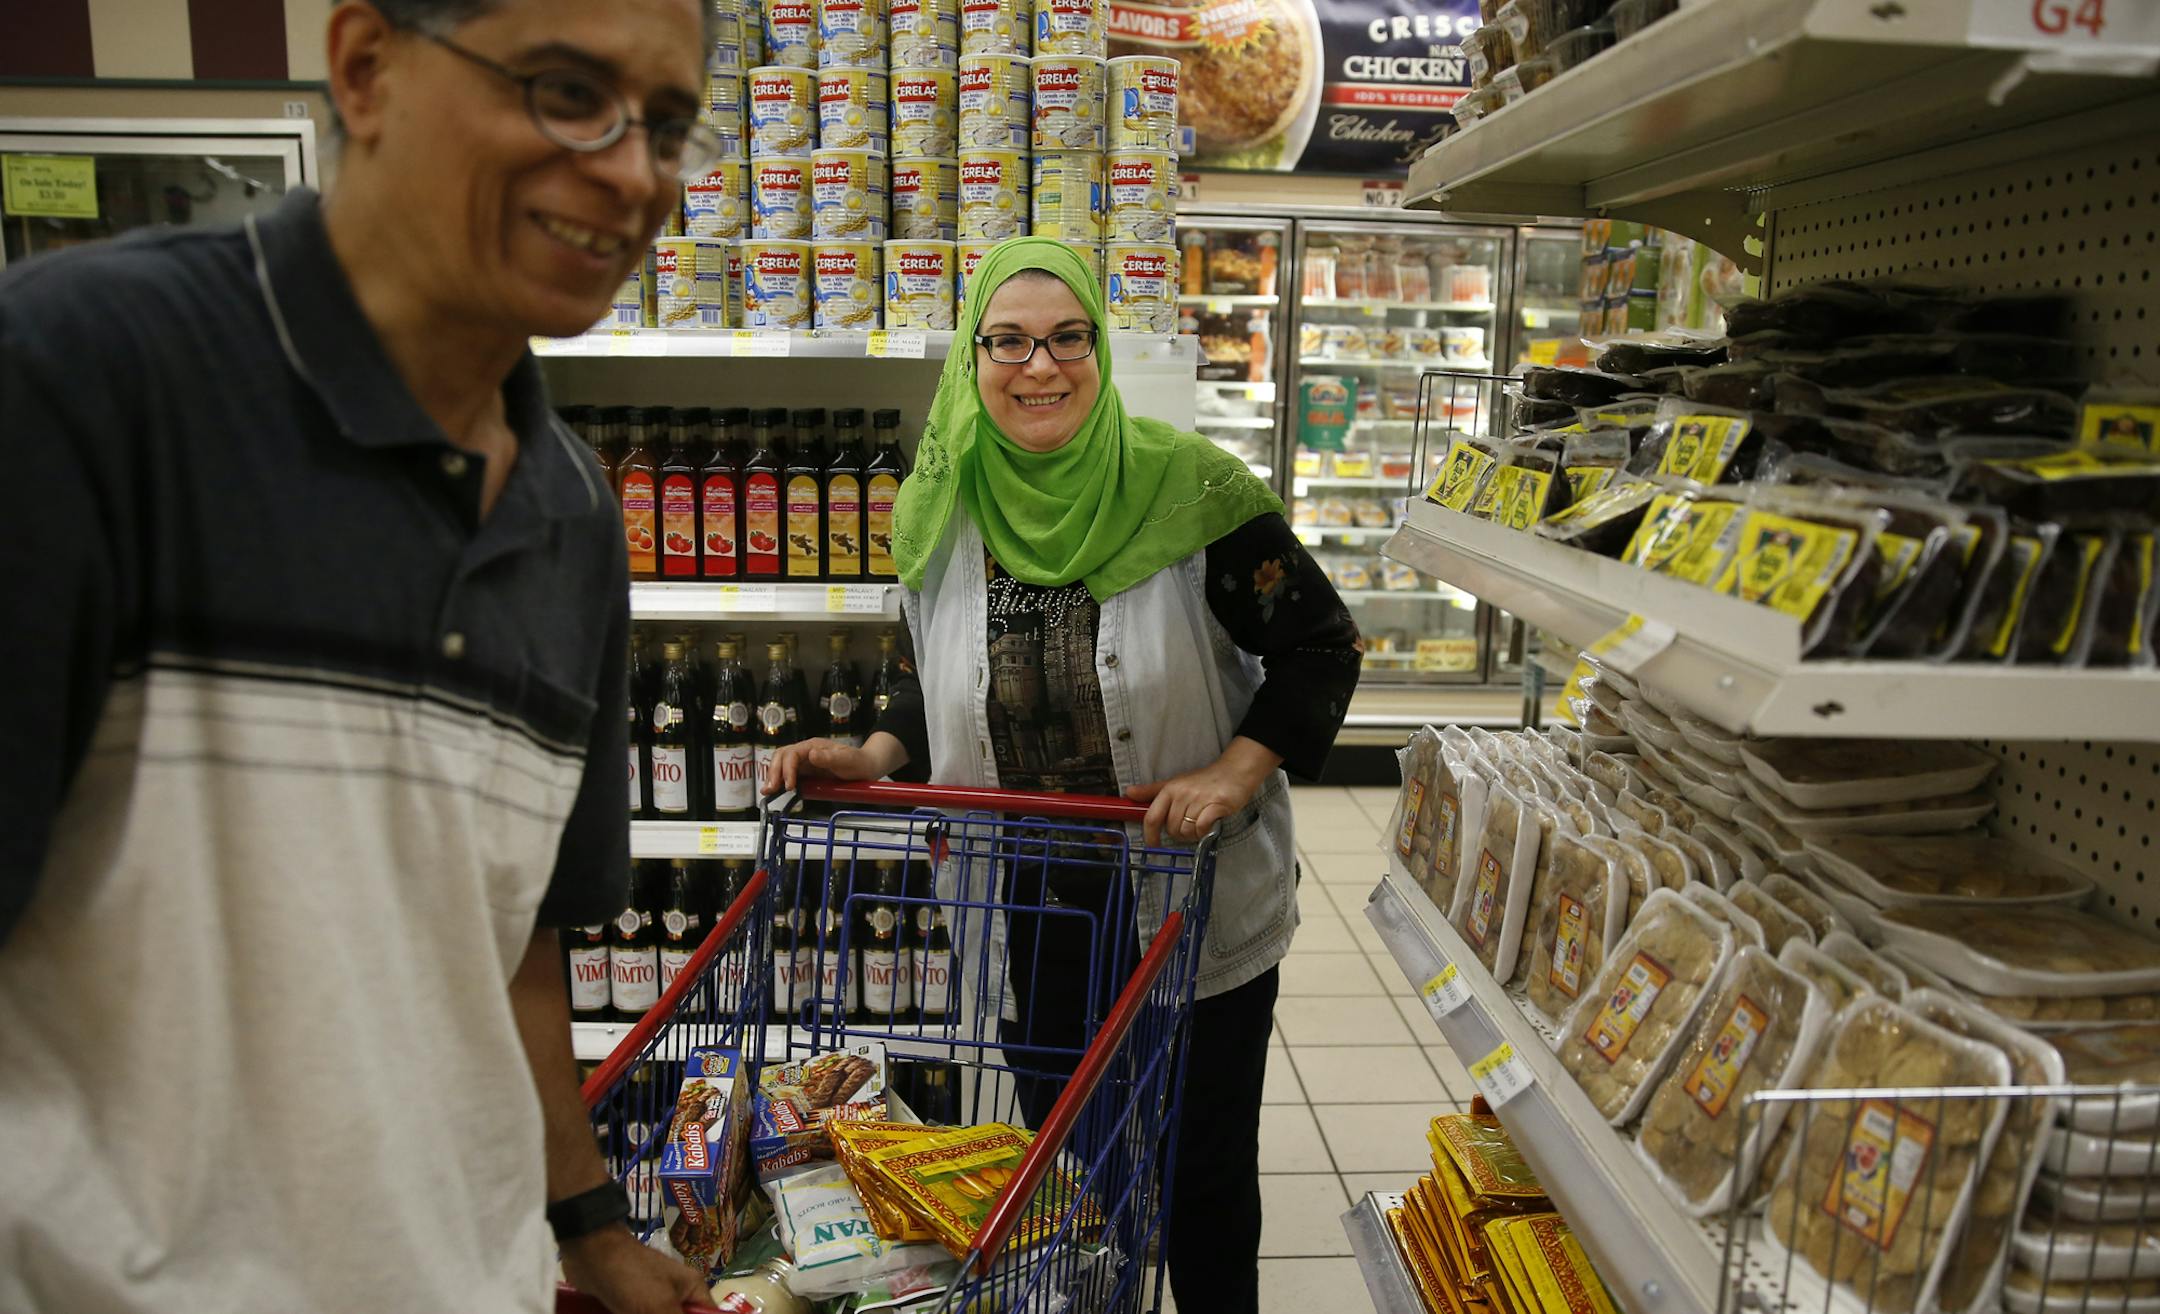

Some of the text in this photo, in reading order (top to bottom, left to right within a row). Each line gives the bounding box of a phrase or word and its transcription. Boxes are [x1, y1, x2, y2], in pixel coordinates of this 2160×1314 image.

[770, 7, 812, 19] CERELAC
[2032, 0, 2106, 37] G4
[1343, 55, 1467, 83] CHICKEN
[1036, 73, 1081, 85] CERELAC
[752, 84, 794, 95] CERELAC
[896, 85, 938, 96] CERELAC
[1329, 113, 1415, 142] Chicken
[812, 167, 851, 178] CERELAC
[960, 166, 1002, 178] CERELAC
[1111, 168, 1157, 180] CERELAC
[758, 174, 802, 185] CERELAC
[754, 258, 801, 269] CERELAC
[816, 258, 858, 269] CERELAC
[898, 258, 944, 270] CERELAC
[1122, 260, 1168, 272] CERELAC
[611, 963, 655, 985] VIMTO
[773, 1100, 799, 1133] Kababs
[685, 1123, 705, 1169] Kababs
[760, 1148, 809, 1173] Kababs
[673, 1181, 699, 1223] Kababs
